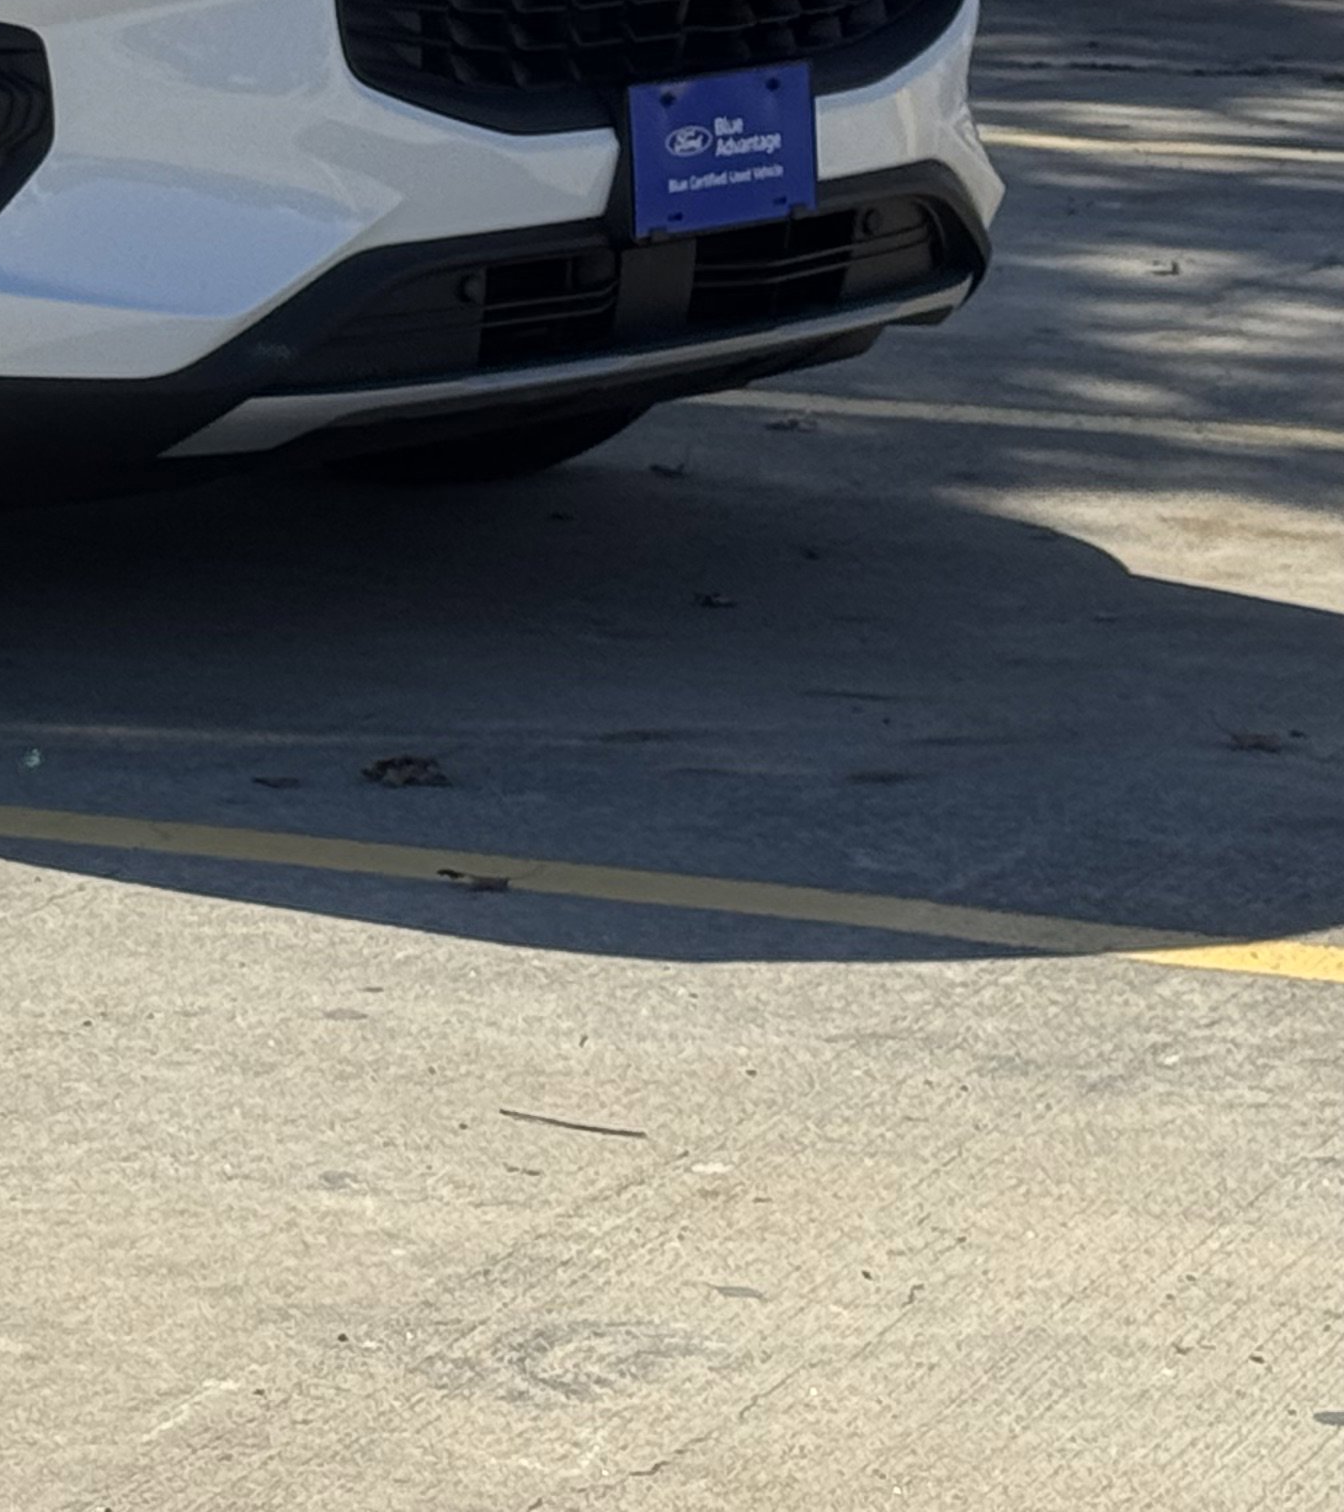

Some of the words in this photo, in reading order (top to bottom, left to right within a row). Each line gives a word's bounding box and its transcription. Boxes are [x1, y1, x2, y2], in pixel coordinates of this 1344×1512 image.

[714, 115, 744, 136] Blue
[673, 128, 704, 154] Ford
[715, 132, 782, 156] Advantage
[667, 178, 689, 193] Blue
[689, 171, 728, 190] Certified
[728, 169, 752, 183] Used
[752, 164, 784, 180] Vehicle
